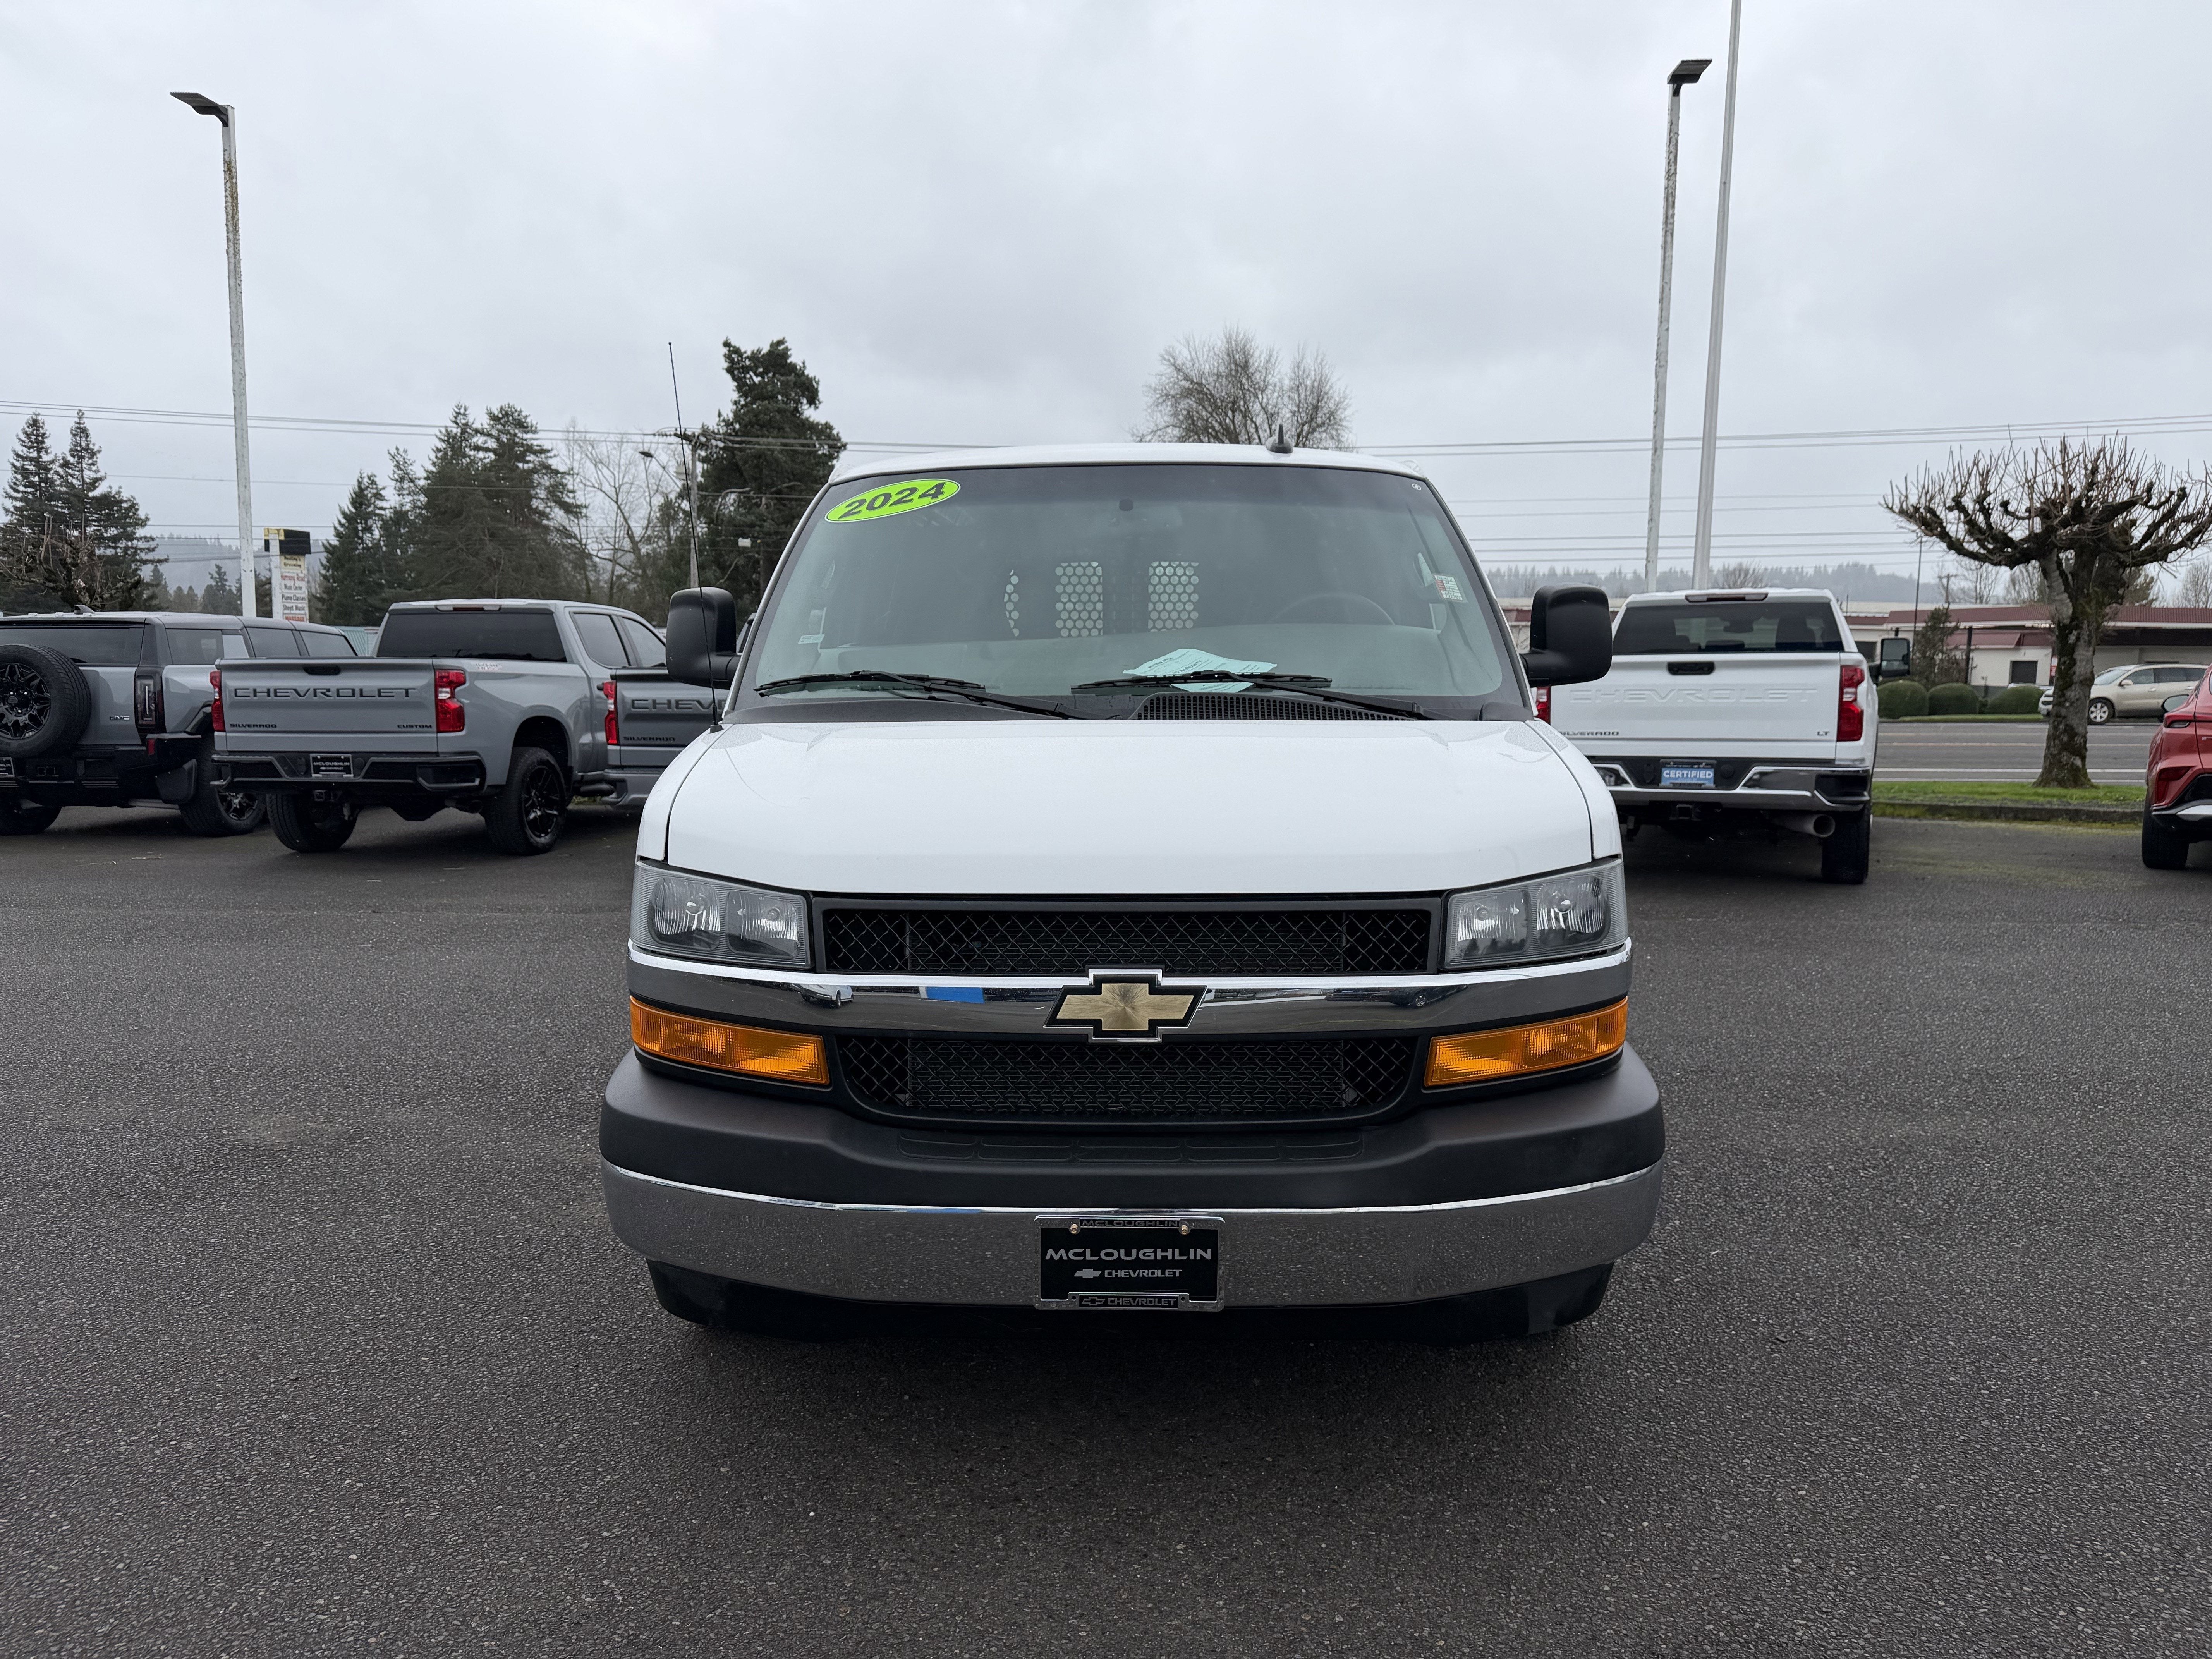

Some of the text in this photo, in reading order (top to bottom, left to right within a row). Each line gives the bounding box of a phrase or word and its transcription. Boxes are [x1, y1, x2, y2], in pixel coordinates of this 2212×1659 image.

[838, 482, 946, 520] 2024
[235, 688, 416, 697] CHEVROLET
[1570, 689, 1817, 703] CHEVROLET
[1663, 770, 1713, 778] CERTIFIED
[1046, 1249, 1212, 1261] MCLOUGHLIN
[1104, 1269, 1182, 1278] CHEVROLET
[1108, 1298, 1177, 1306] CHEVROLET
